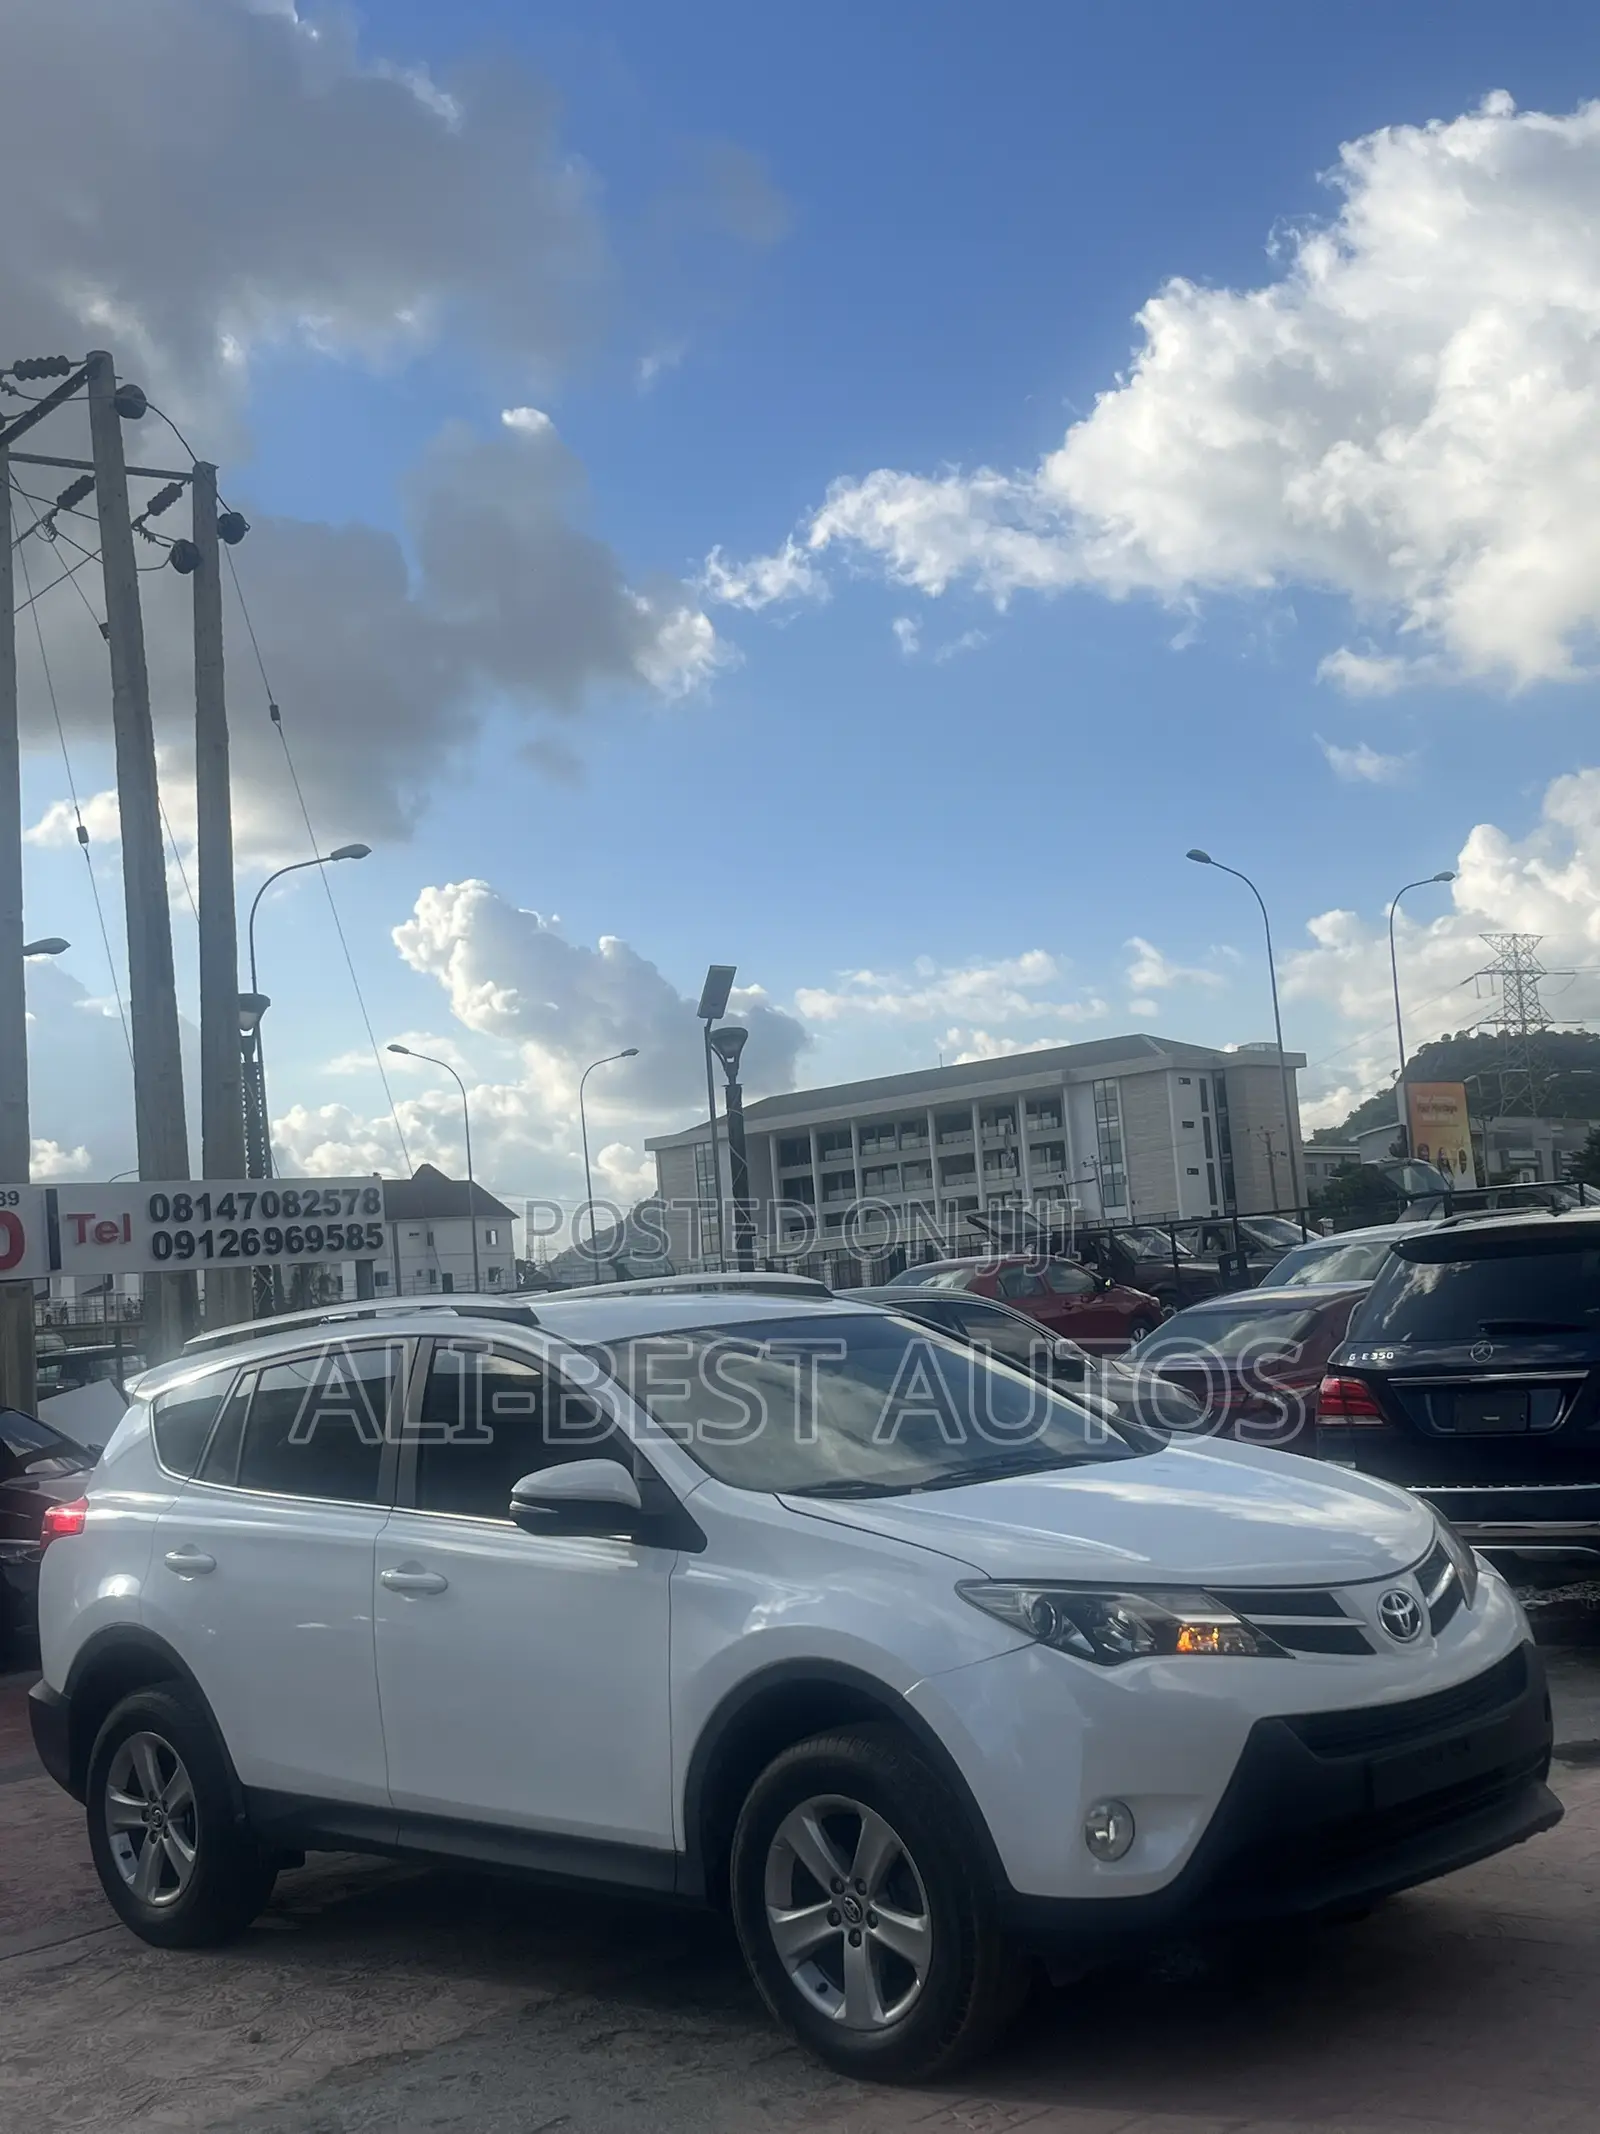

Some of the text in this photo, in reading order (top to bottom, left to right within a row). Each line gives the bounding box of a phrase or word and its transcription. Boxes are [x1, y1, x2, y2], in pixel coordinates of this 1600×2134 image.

[150, 1187, 382, 1222] 08147082578
[66, 1212, 132, 1244] Tel
[152, 1222, 384, 1260] 09126969585
